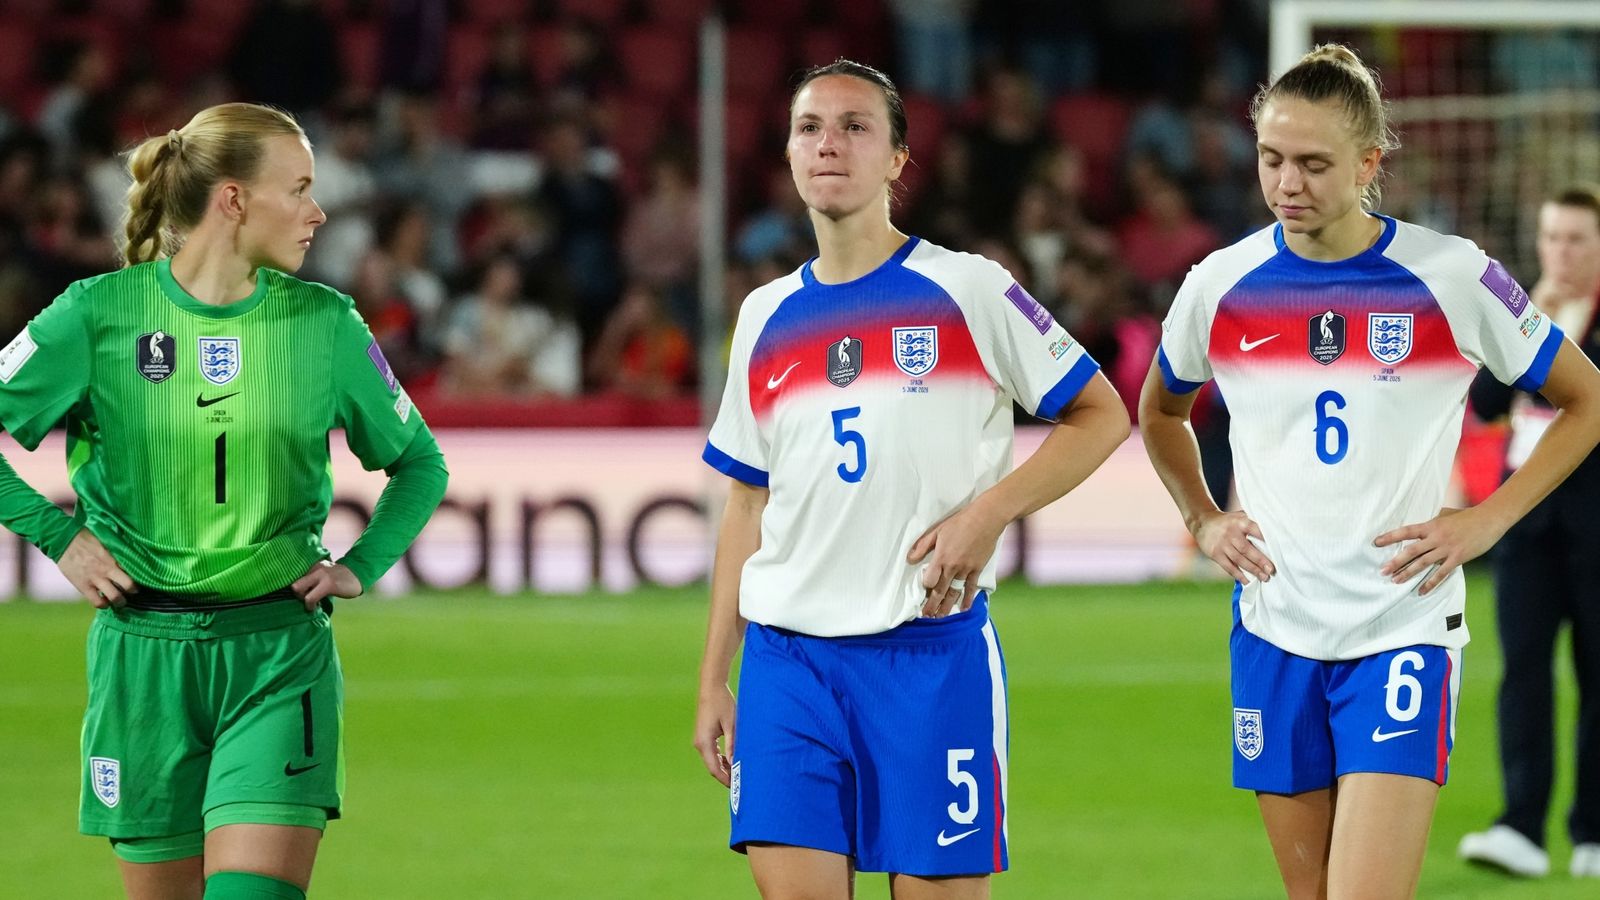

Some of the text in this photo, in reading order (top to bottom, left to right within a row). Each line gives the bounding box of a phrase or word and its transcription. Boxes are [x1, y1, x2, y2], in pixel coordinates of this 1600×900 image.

[831, 406, 867, 483] 5
[1313, 390, 1348, 465] 6
[215, 431, 226, 504] 1
[302, 688, 313, 757] 1
[1384, 651, 1425, 722] 6
[947, 748, 979, 824] 5
